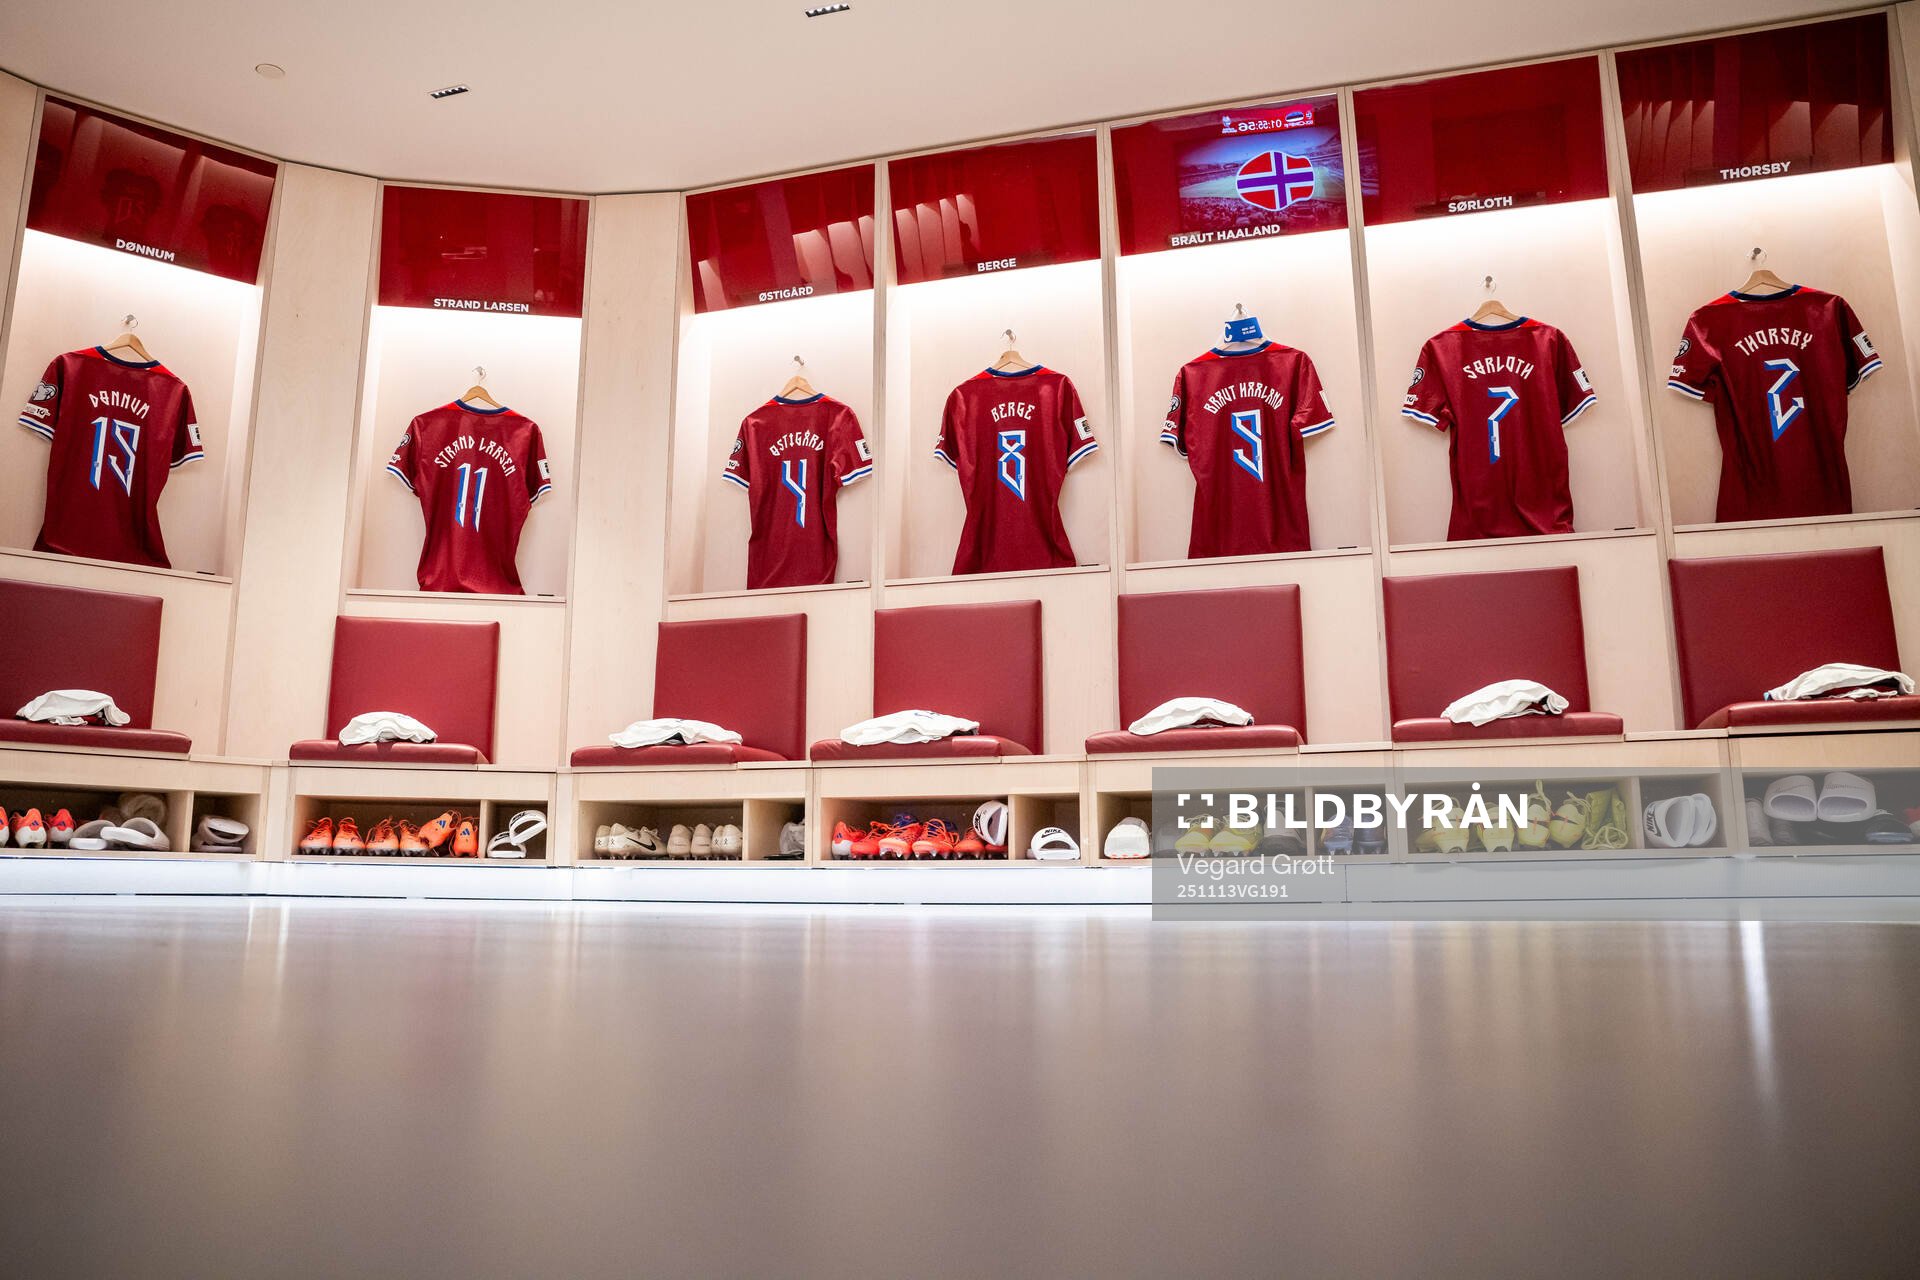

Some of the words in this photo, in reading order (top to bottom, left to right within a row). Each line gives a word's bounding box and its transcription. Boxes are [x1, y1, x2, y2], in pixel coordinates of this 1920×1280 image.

[1720, 161, 1791, 180] THORSBY
[1448, 195, 1513, 213] SØRLOTH
[1171, 231, 1214, 247] BRAUT
[1216, 224, 1281, 241] HAALAND
[115, 238, 176, 262] DØNNUM
[977, 258, 1017, 272] BERGE
[434, 298, 481, 310] STRAND
[484, 300, 529, 313] LARSEN
[758, 286, 814, 302] ØSTIGÅRD
[1734, 327, 1813, 356] THORSBY
[1462, 355, 1535, 380] SØRLOTH
[88, 390, 150, 419] DØNNUM
[991, 401, 1036, 423] BERGE
[1203, 384, 1237, 415] BRAUT
[1239, 381, 1285, 410] HAALAND
[1764, 358, 1805, 442] 2
[1487, 386, 1520, 464] 7
[89, 416, 141, 497] 19
[434, 435, 475, 468] STRAND
[478, 437, 516, 477] LARSEN
[769, 429, 824, 456] ØSTIGÅRD
[1231, 409, 1264, 483] 9
[998, 430, 1026, 502] 8
[454, 462, 489, 533] 11
[782, 459, 808, 528] 4
[1645, 810, 1656, 833] NIKE
